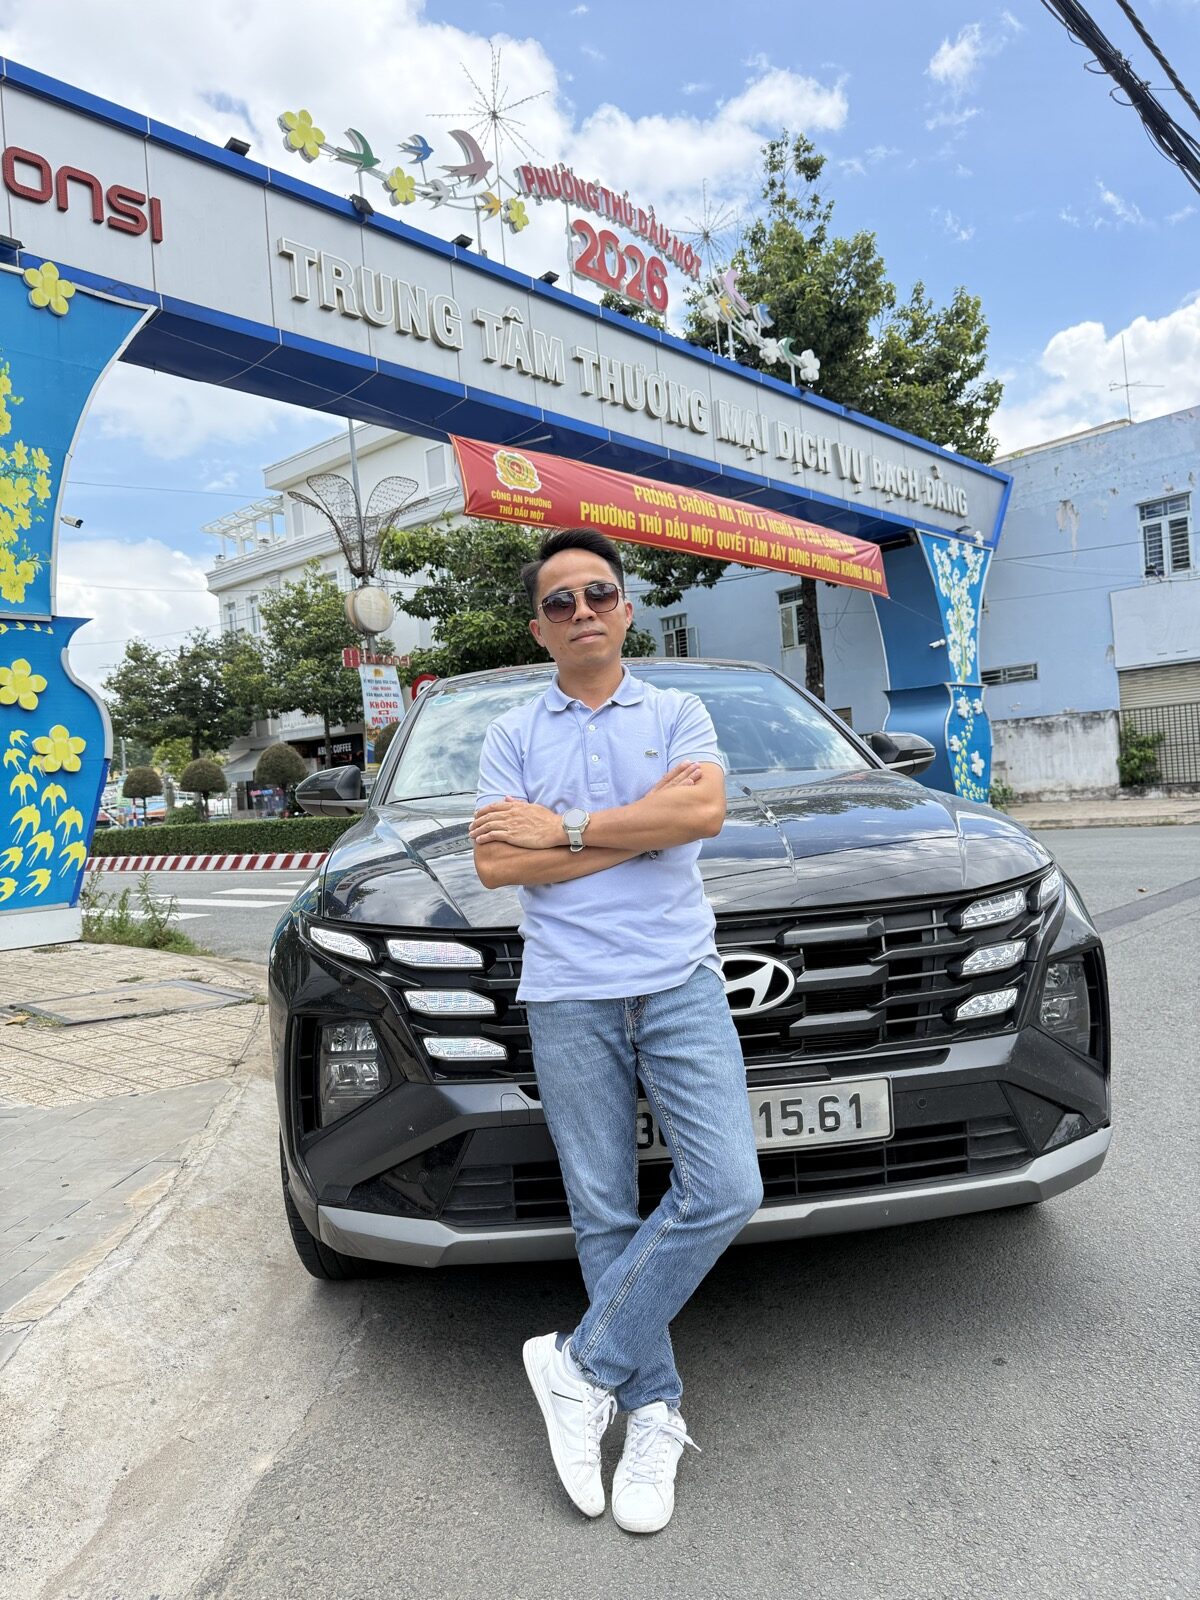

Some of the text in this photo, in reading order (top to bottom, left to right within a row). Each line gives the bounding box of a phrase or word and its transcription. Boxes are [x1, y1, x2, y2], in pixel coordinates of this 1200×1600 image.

[571, 219, 669, 313] 2026
[278, 237, 464, 350] TRUNG
[472, 306, 566, 386] TÂM
[572, 346, 709, 434] THƯƠNG
[717, 399, 769, 461] MẠI
[774, 420, 831, 474] DỊCH
[832, 442, 865, 493] VỤ
[869, 455, 919, 503] BẠCH
[491, 489, 512, 502] CÔNG
[513, 494, 523, 504] AN
[633, 485, 677, 509] PHÒNG
[717, 504, 735, 523] MA
[580, 501, 636, 530] PHƯỜNG
[639, 511, 662, 536] THỦ
[691, 524, 714, 549] MỘT
[716, 530, 746, 553] QUYẾT
[748, 536, 769, 558] TÂM
[770, 541, 786, 561] XÂY
[788, 548, 810, 568] DỰNG
[811, 553, 841, 574] PHƯỜNG
[841, 560, 862, 579] KHÔNG
[863, 565, 873, 583] MA
[369, 699, 398, 709] KHÔNG
[332, 742, 352, 754] COFFEE
